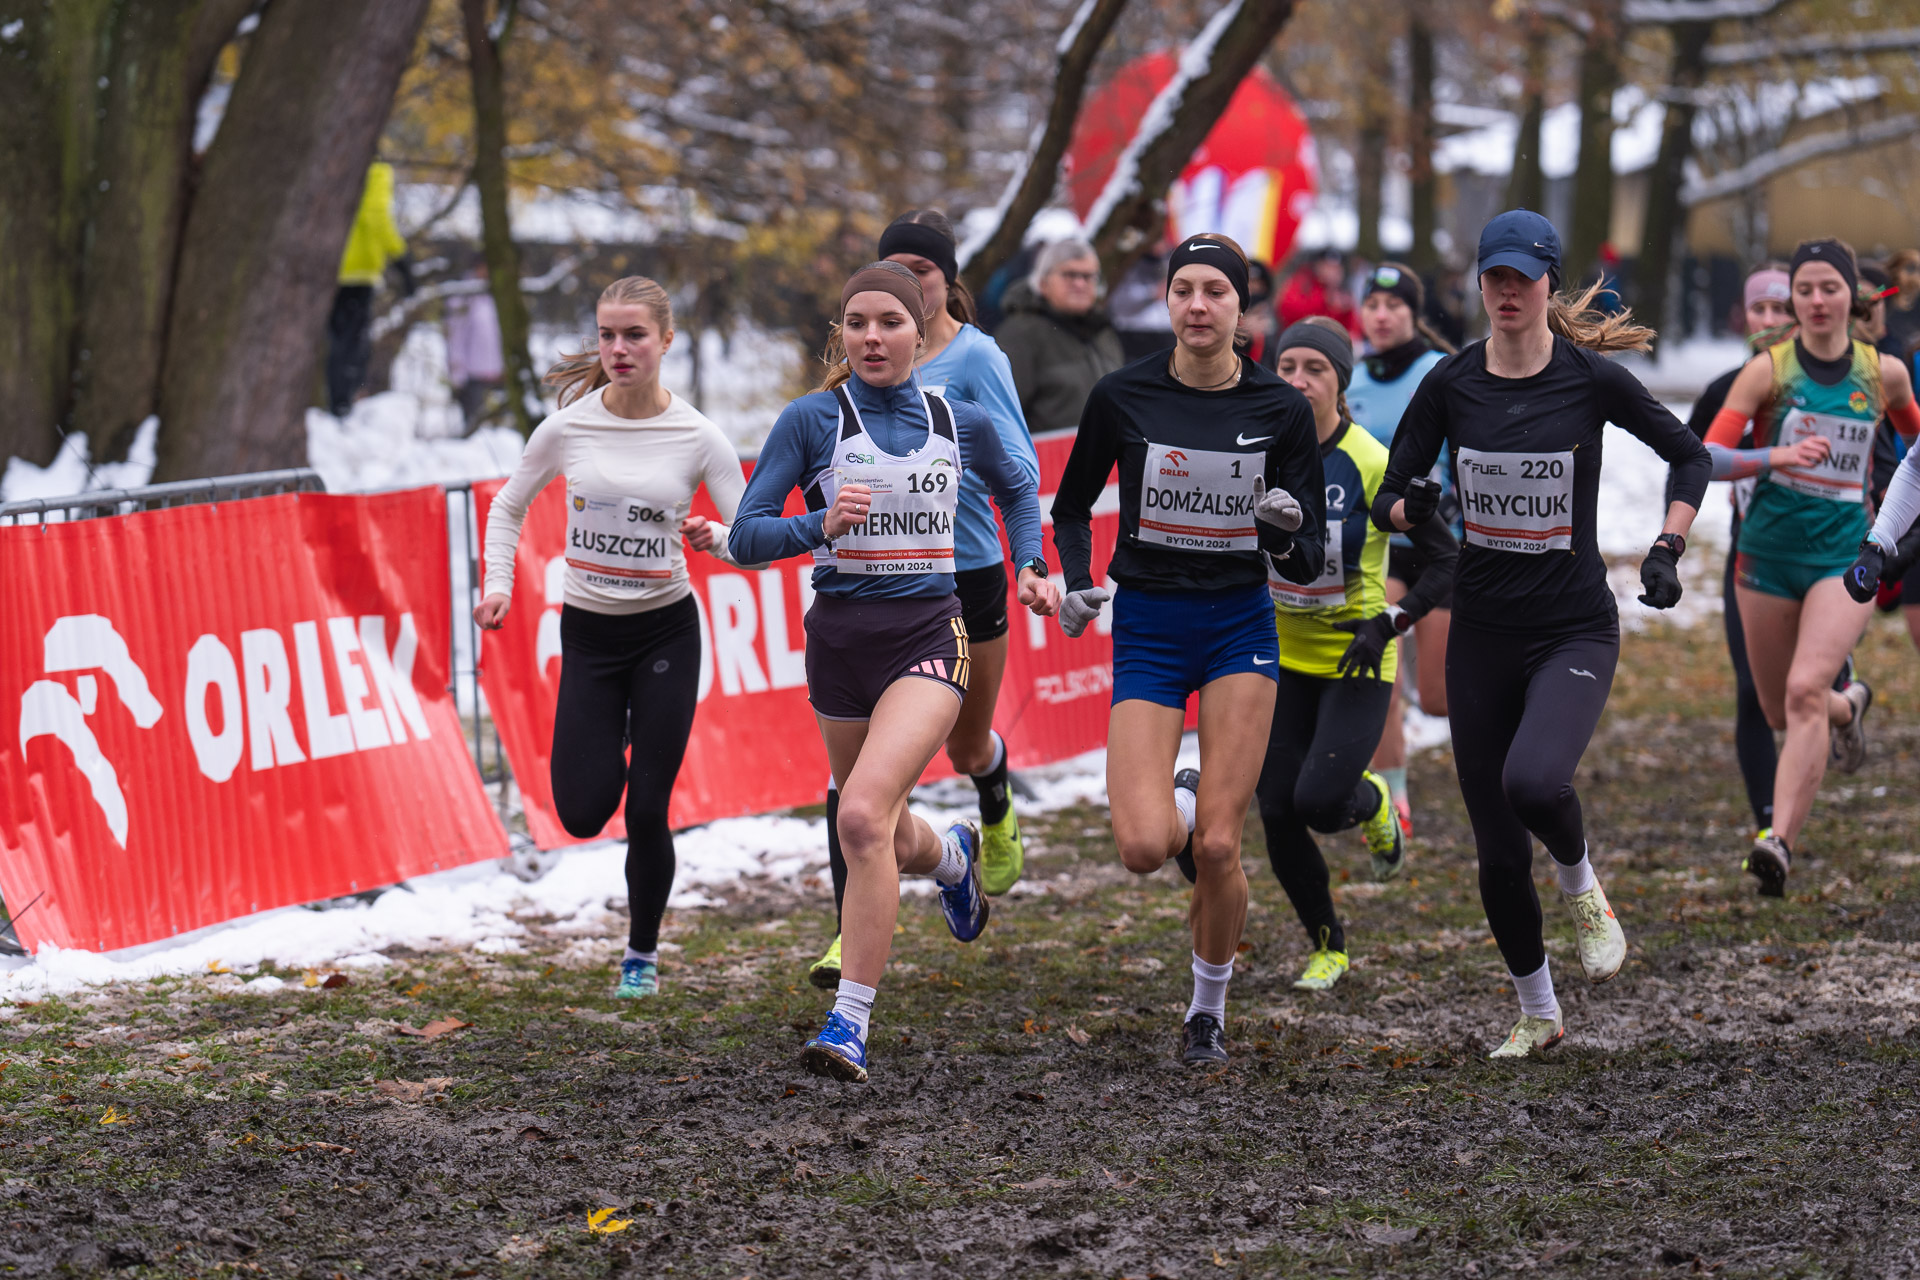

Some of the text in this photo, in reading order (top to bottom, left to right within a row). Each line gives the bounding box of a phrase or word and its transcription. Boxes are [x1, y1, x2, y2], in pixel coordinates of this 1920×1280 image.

[1838, 424, 1868, 443] 118
[1159, 467, 1190, 478] ORLEN
[1230, 459, 1242, 479] 1
[1472, 463, 1508, 476] FUEL
[1520, 459, 1565, 480] 220
[907, 472, 948, 494] 169
[1146, 486, 1254, 517] DOMŻALSKA
[1464, 490, 1569, 518] HRYCIUK
[626, 504, 666, 523] 506
[571, 527, 666, 559] ŁUSZCZKI
[1166, 536, 1231, 549] BYTOM 2024
[1487, 538, 1547, 551] BYTOM 2024
[865, 562, 934, 572] BYTOM 2024
[586, 574, 646, 589] BYTOM 2024
[185, 612, 432, 783] ORLEN
